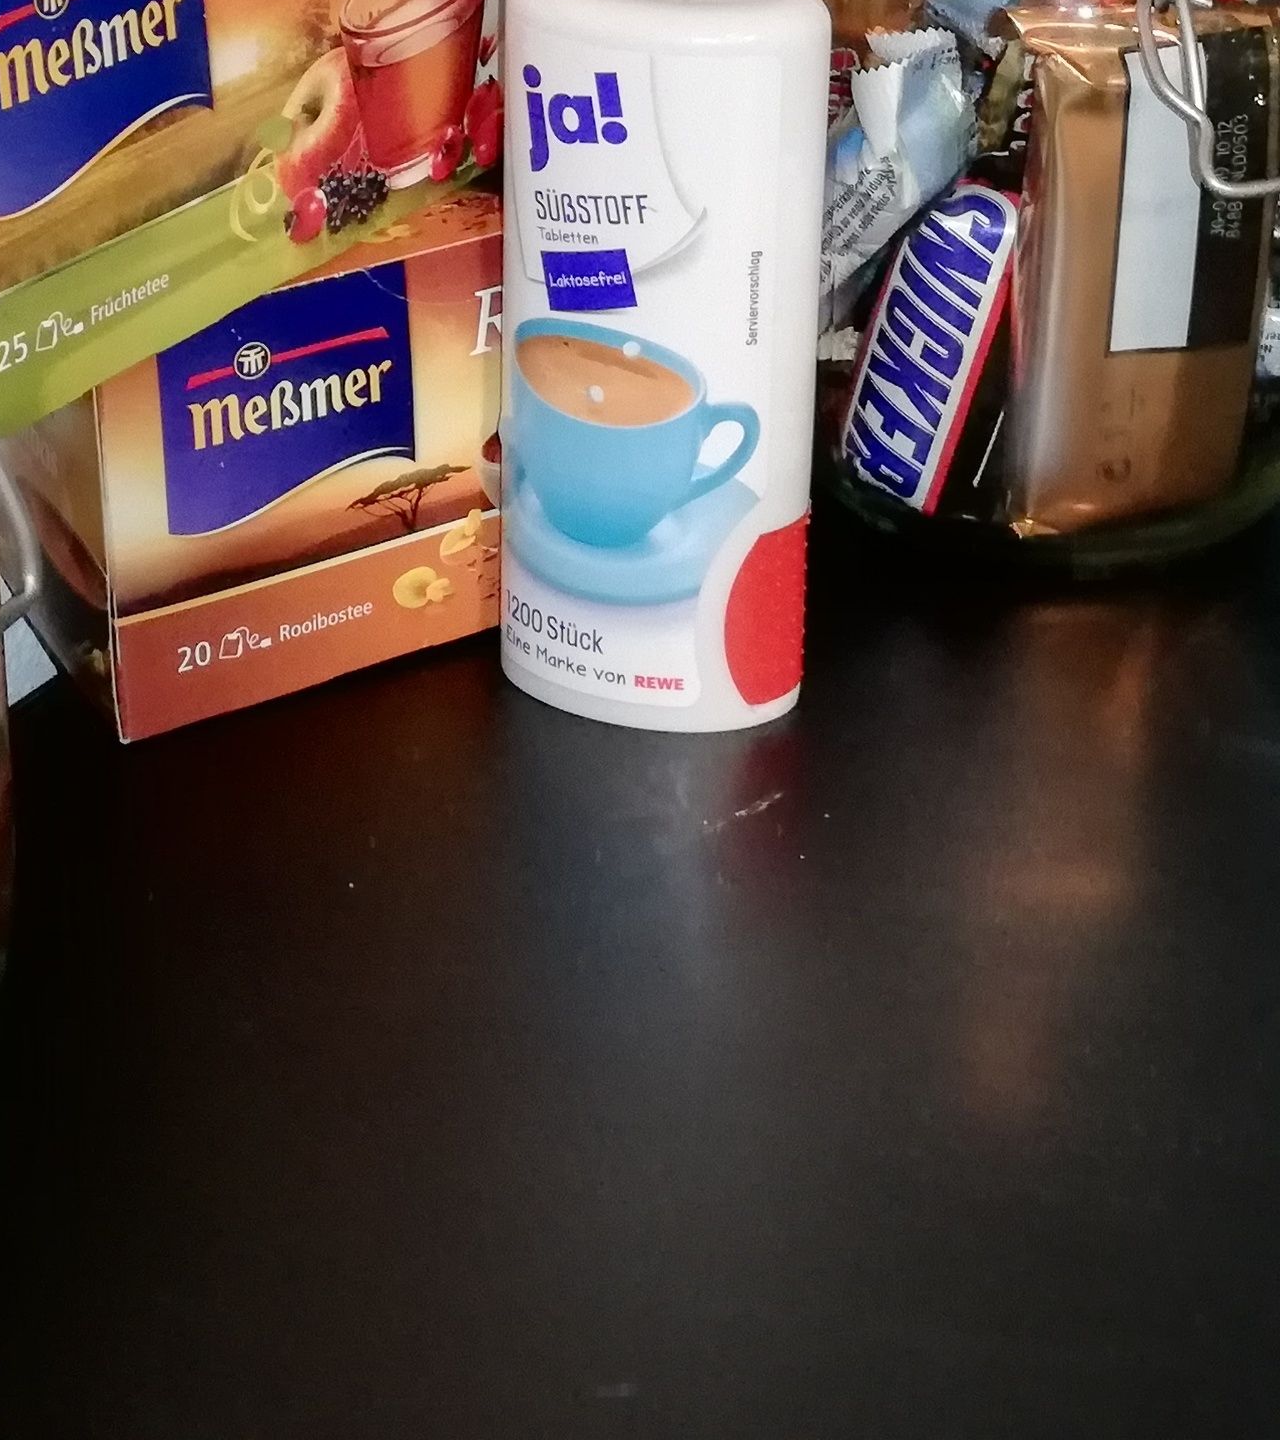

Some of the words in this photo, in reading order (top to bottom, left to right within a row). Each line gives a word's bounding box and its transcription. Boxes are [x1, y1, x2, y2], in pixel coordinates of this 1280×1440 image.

[522, 64, 628, 172] ja!
[537, 226, 600, 246] Tabletten
[90, 273, 170, 326] Früchtetee
[548, 271, 627, 289] Laktosefrei
[745, 249, 764, 347] Serviervorschlag
[846, 193, 1010, 500] SNICKER
[186, 359, 392, 451] Meßmer
[177, 640, 212, 673] 20
[279, 601, 374, 643] Rooibostee
[505, 588, 543, 635] 1200
[546, 615, 604, 655] Stück
[505, 625, 532, 656] Eine
[536, 645, 587, 677] Marke
[593, 667, 626, 686] von
[633, 674, 685, 691] REWE
